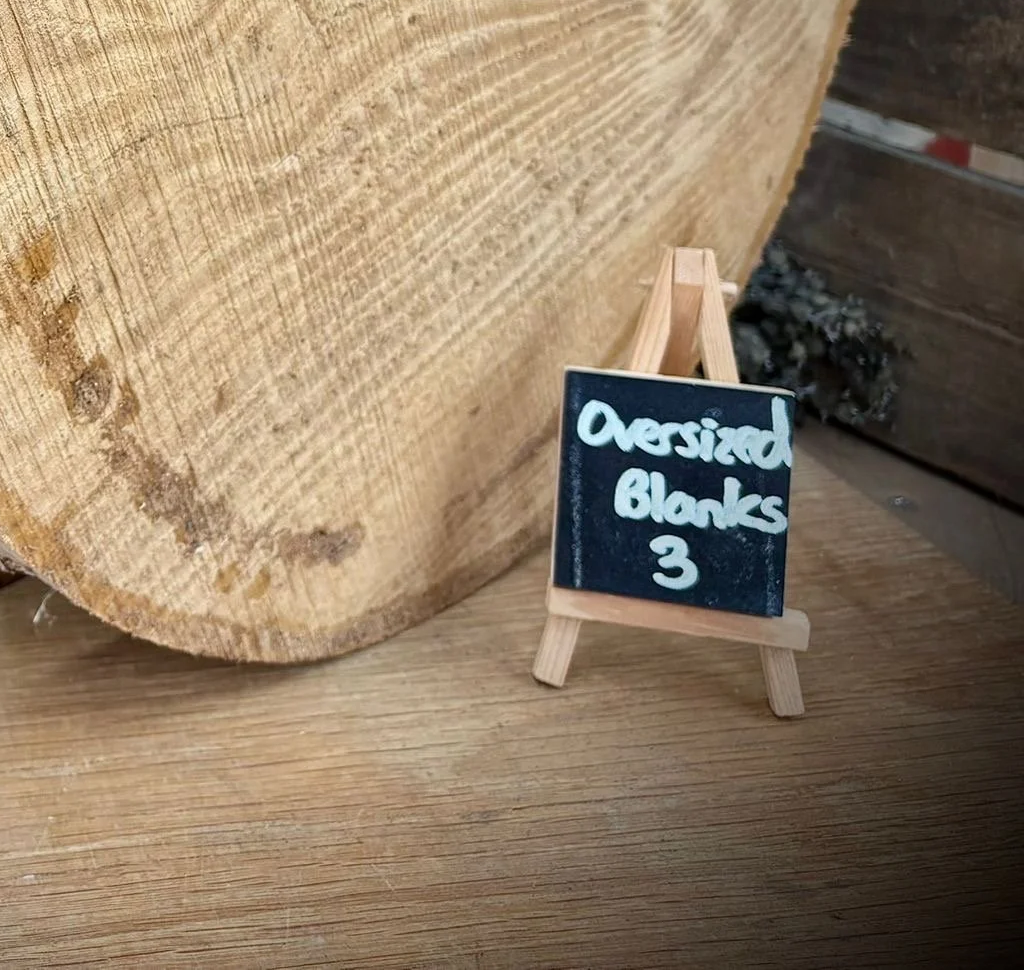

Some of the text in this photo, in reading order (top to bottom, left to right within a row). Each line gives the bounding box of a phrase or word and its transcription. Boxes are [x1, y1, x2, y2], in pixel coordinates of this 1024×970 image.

[577, 396, 792, 470] Oversized
[614, 467, 788, 534] Blanks
[649, 534, 700, 590] 3
